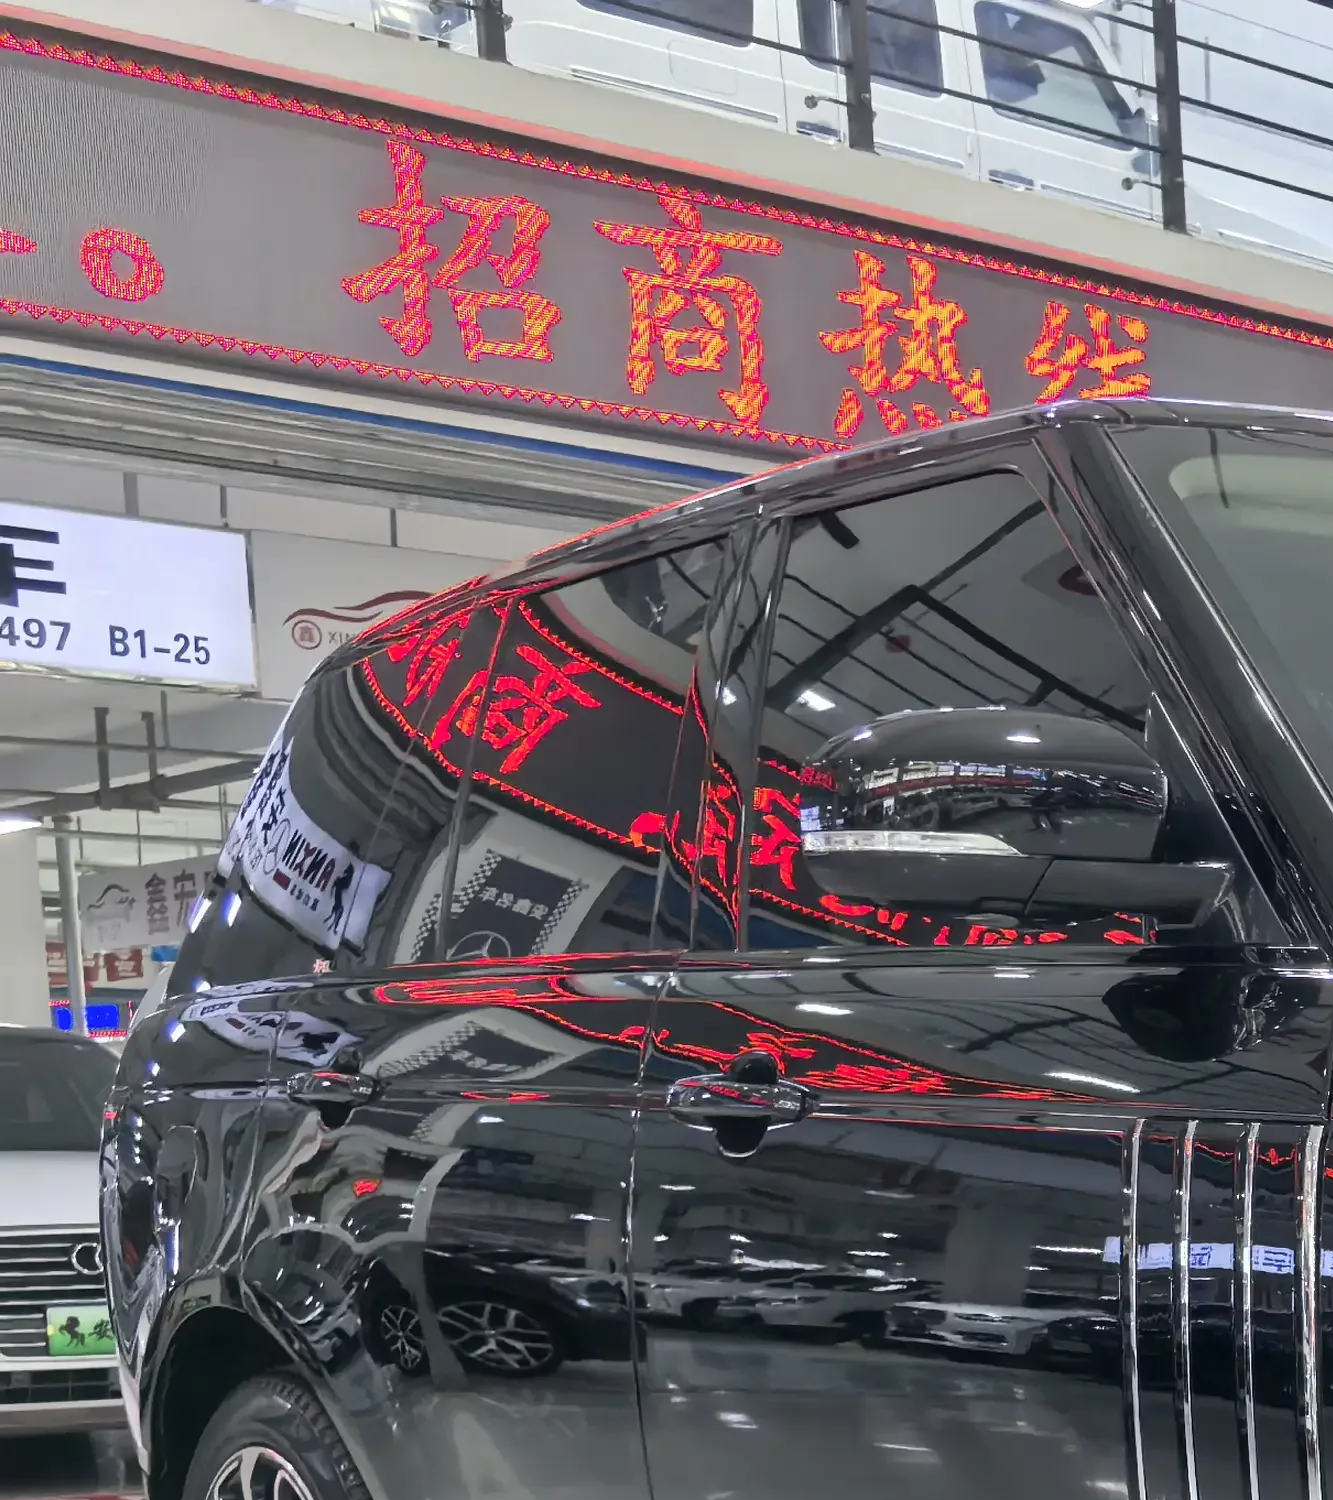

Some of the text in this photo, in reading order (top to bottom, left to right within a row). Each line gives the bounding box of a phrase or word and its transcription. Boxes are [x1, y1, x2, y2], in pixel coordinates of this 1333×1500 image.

[341, 138, 1152, 437] 招商热线
[108, 624, 212, 667] B1-25
